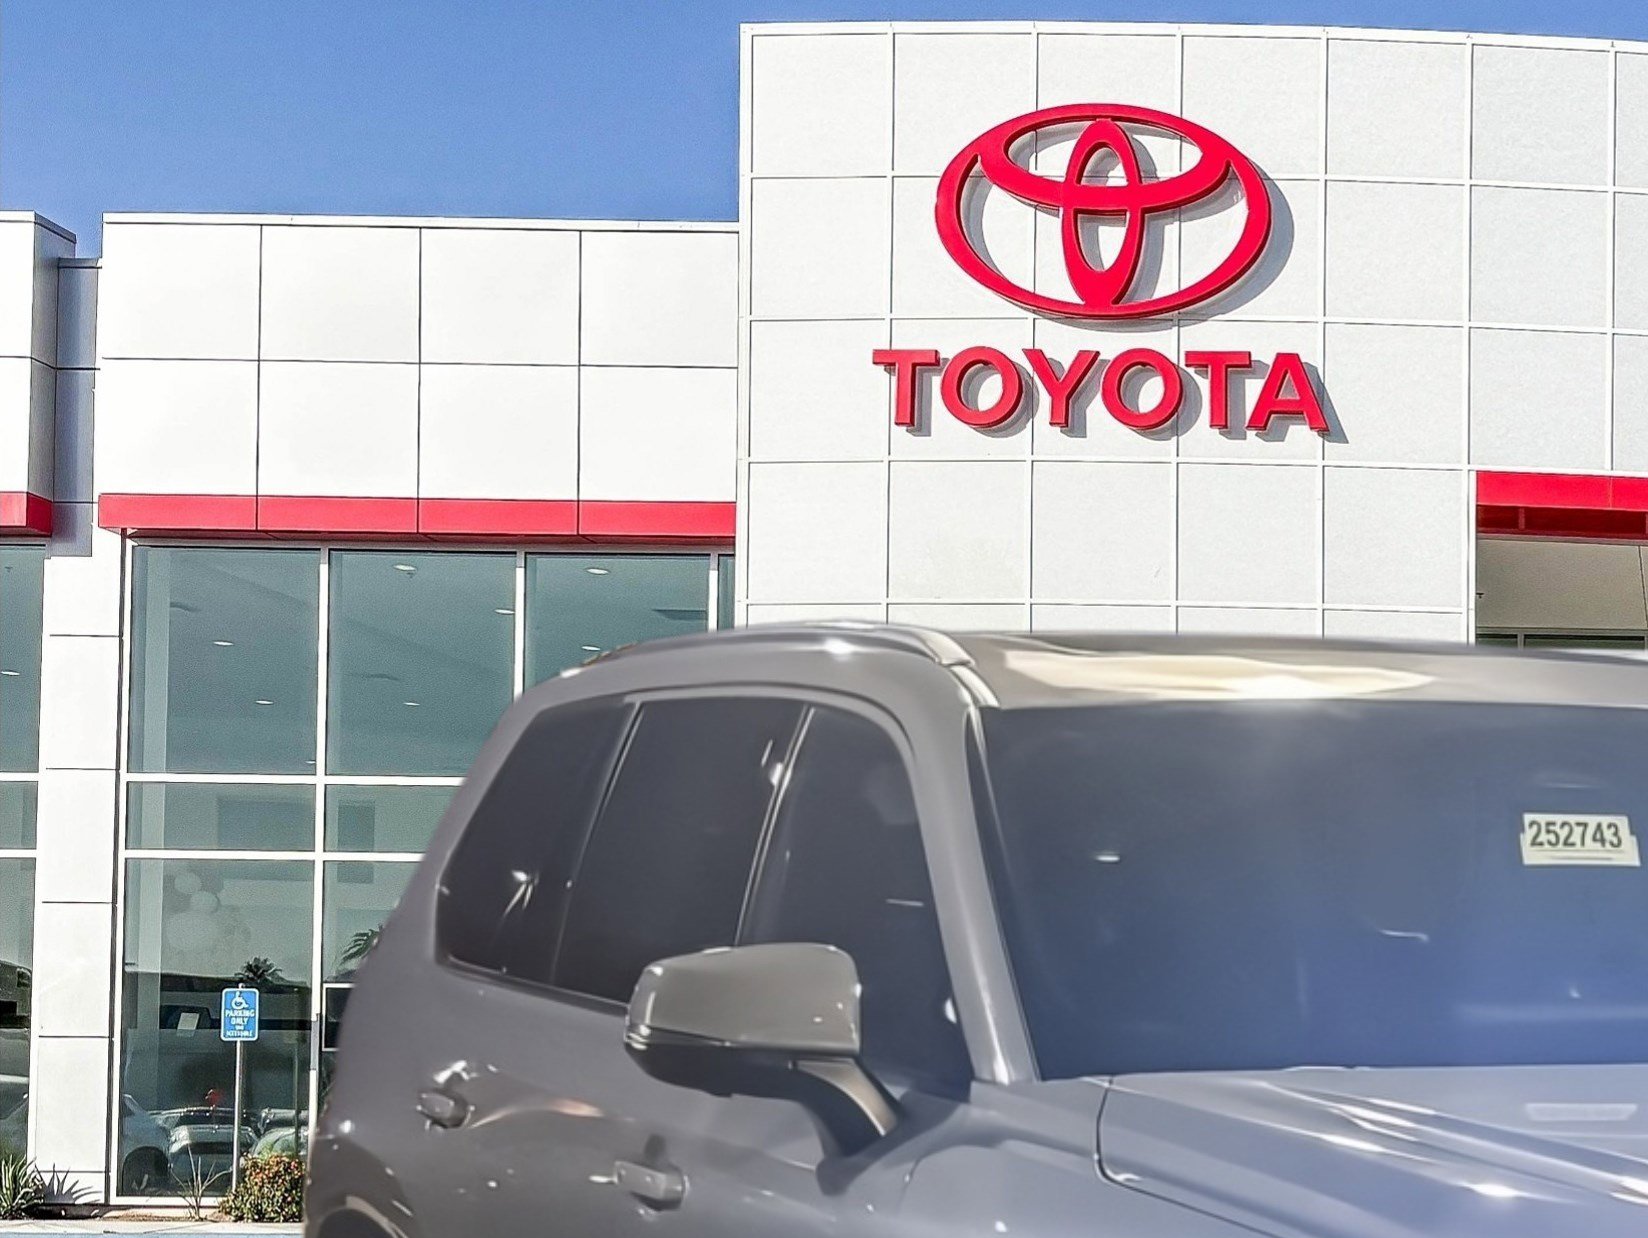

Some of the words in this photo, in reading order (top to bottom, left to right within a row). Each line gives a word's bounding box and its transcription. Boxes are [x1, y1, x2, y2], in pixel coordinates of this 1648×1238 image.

[872, 345, 1330, 433] TOYOTA
[1528, 820, 1622, 848] 252743
[225, 1009, 255, 1017] PARKING
[230, 1017, 249, 1025] ONLY
